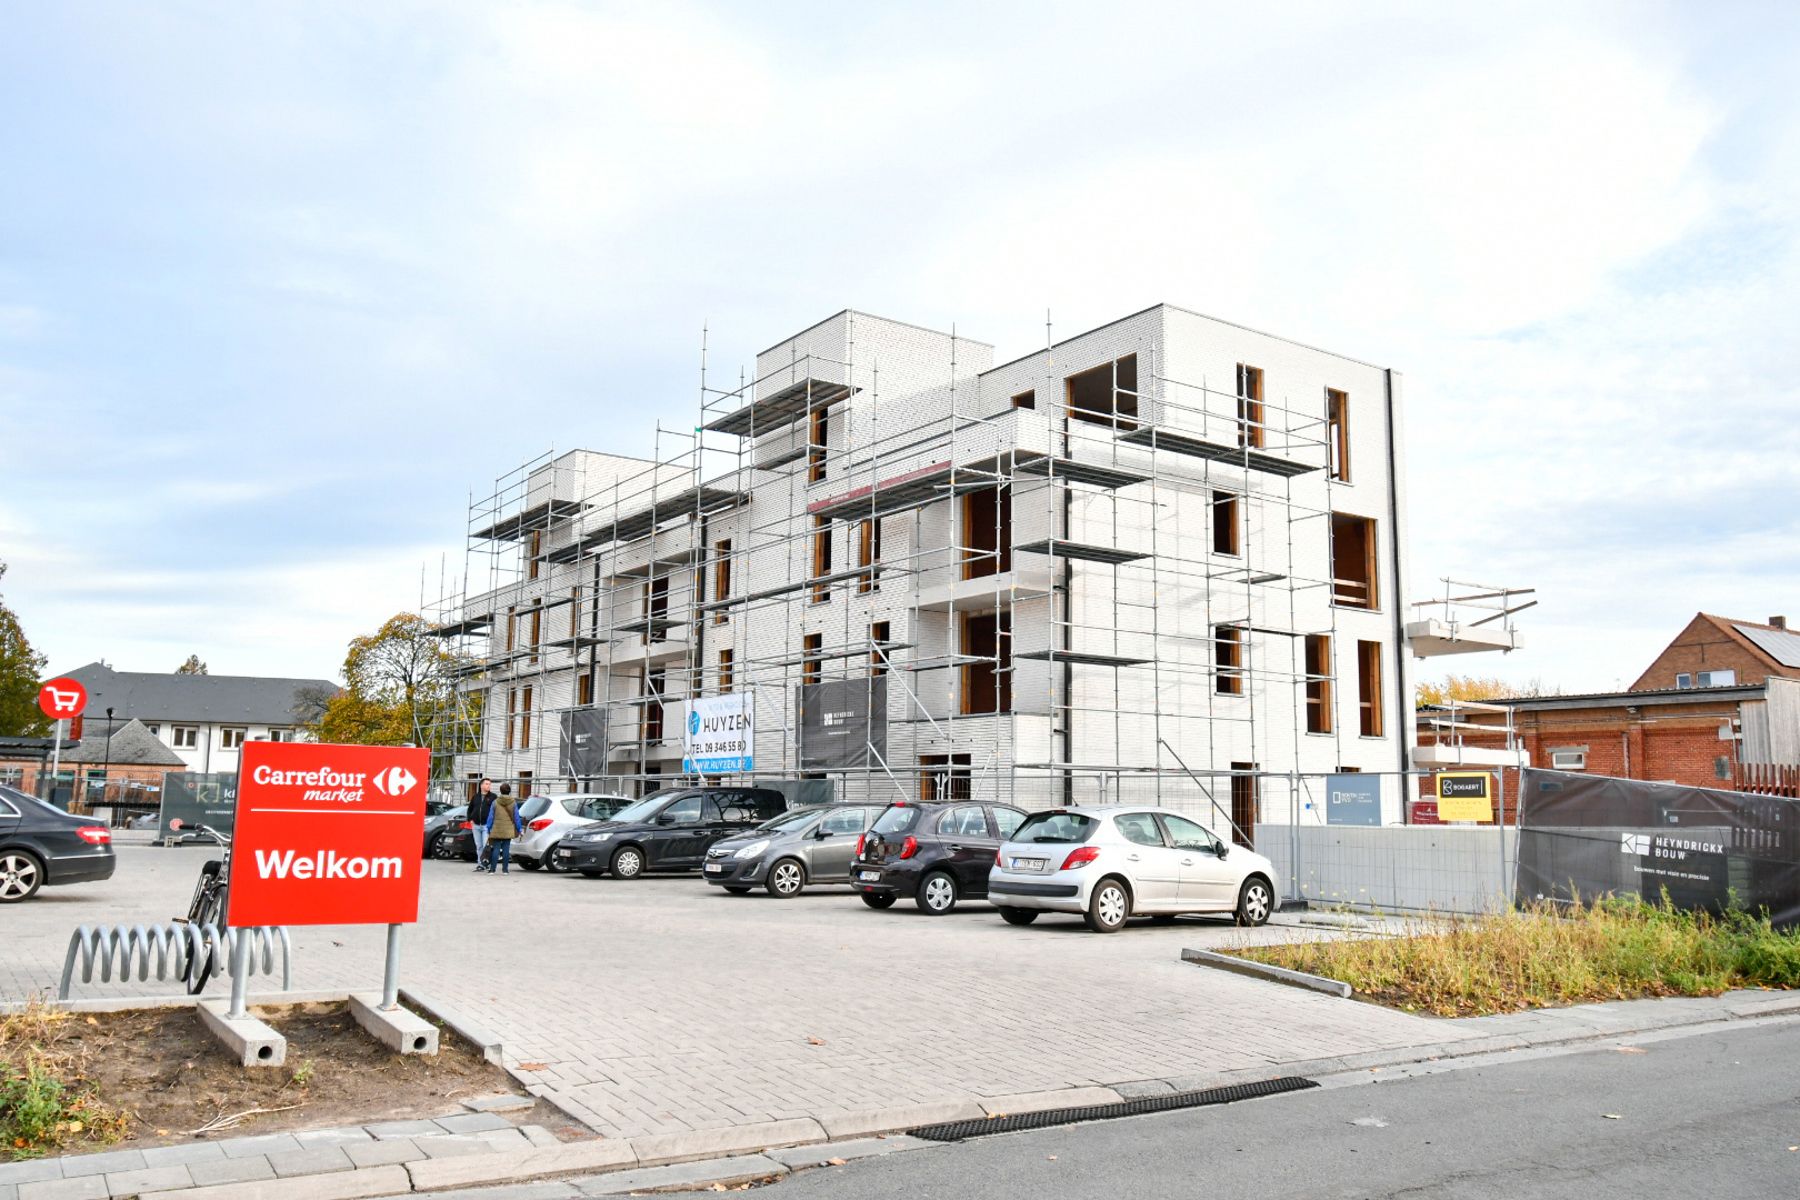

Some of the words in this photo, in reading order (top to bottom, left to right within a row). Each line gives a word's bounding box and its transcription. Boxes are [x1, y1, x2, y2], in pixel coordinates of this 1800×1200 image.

[703, 713, 751, 732] HUYZEN
[691, 743, 704, 754] TEL
[705, 742, 713, 753] 09
[714, 741, 728, 753] 346
[728, 741, 737, 752] 55
[253, 765, 366, 787] Carrefour
[1453, 783, 1480, 791] BOGAERT
[303, 788, 365, 803] market
[1656, 837, 1724, 854] HEYNDRICKX
[1655, 848, 1686, 860] BOUW
[255, 849, 402, 879] Welkom
